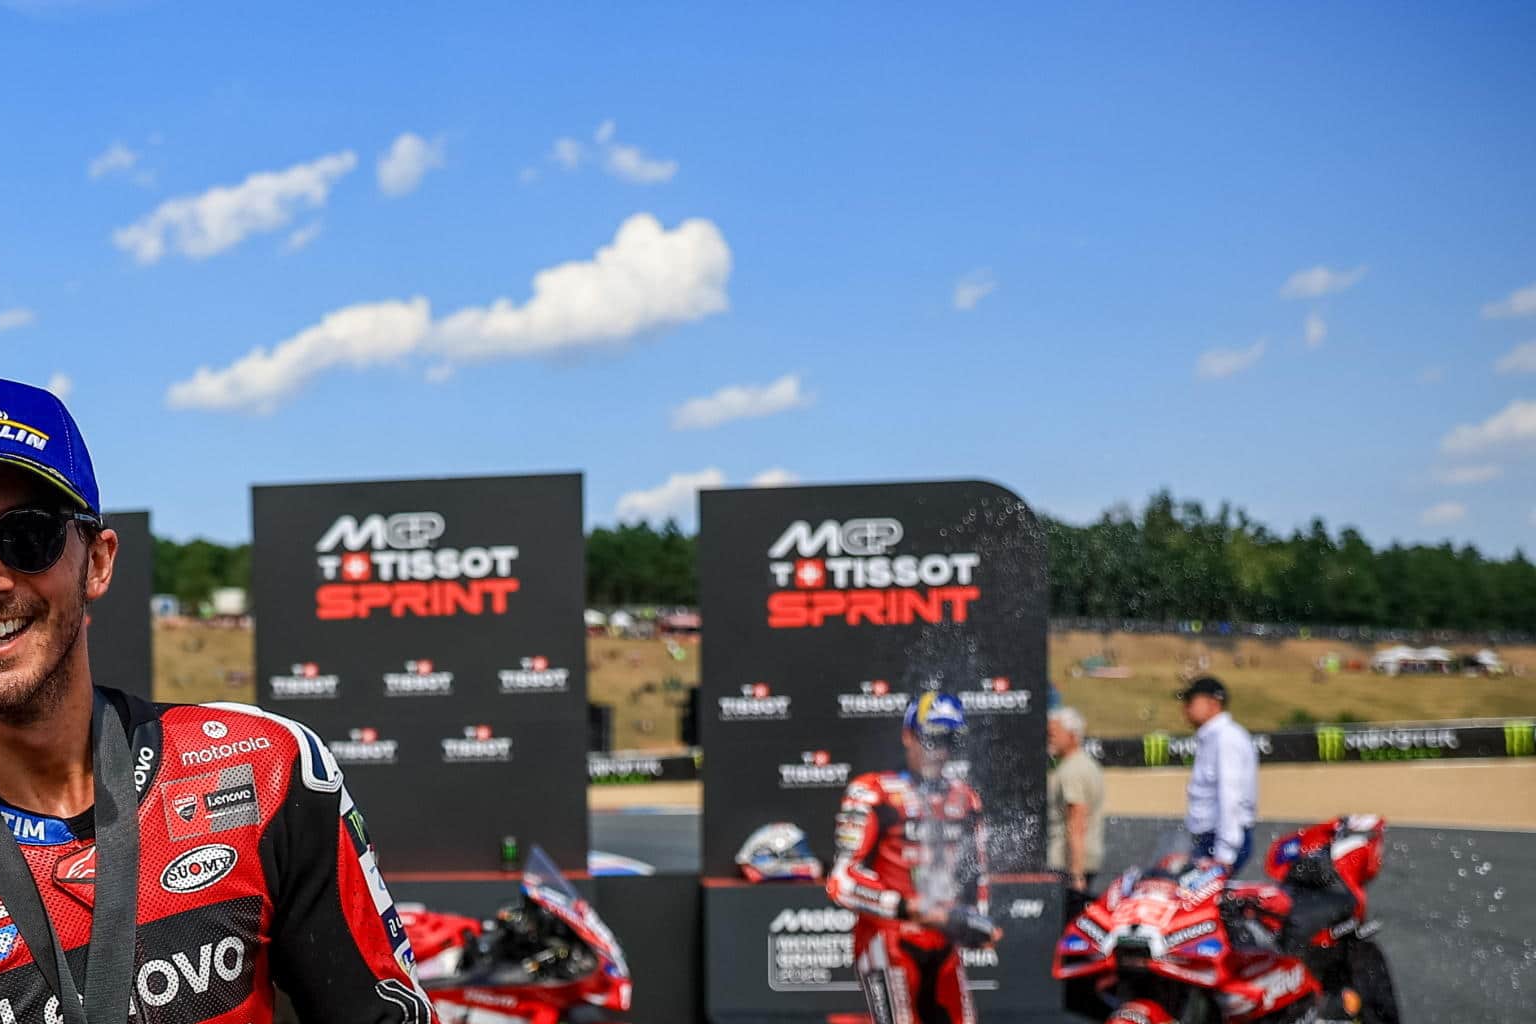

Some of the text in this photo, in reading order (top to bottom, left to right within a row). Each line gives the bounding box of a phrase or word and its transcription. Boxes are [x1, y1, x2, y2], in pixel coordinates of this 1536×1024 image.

[371, 546, 519, 581] TISSOT
[825, 553, 980, 588] TISSOT
[316, 579, 520, 619] SPRINT
[768, 586, 980, 628] SPRINT
[181, 737, 271, 766] motorola
[207, 790, 251, 807] Lenovo
[168, 856, 232, 882] SUOMY
